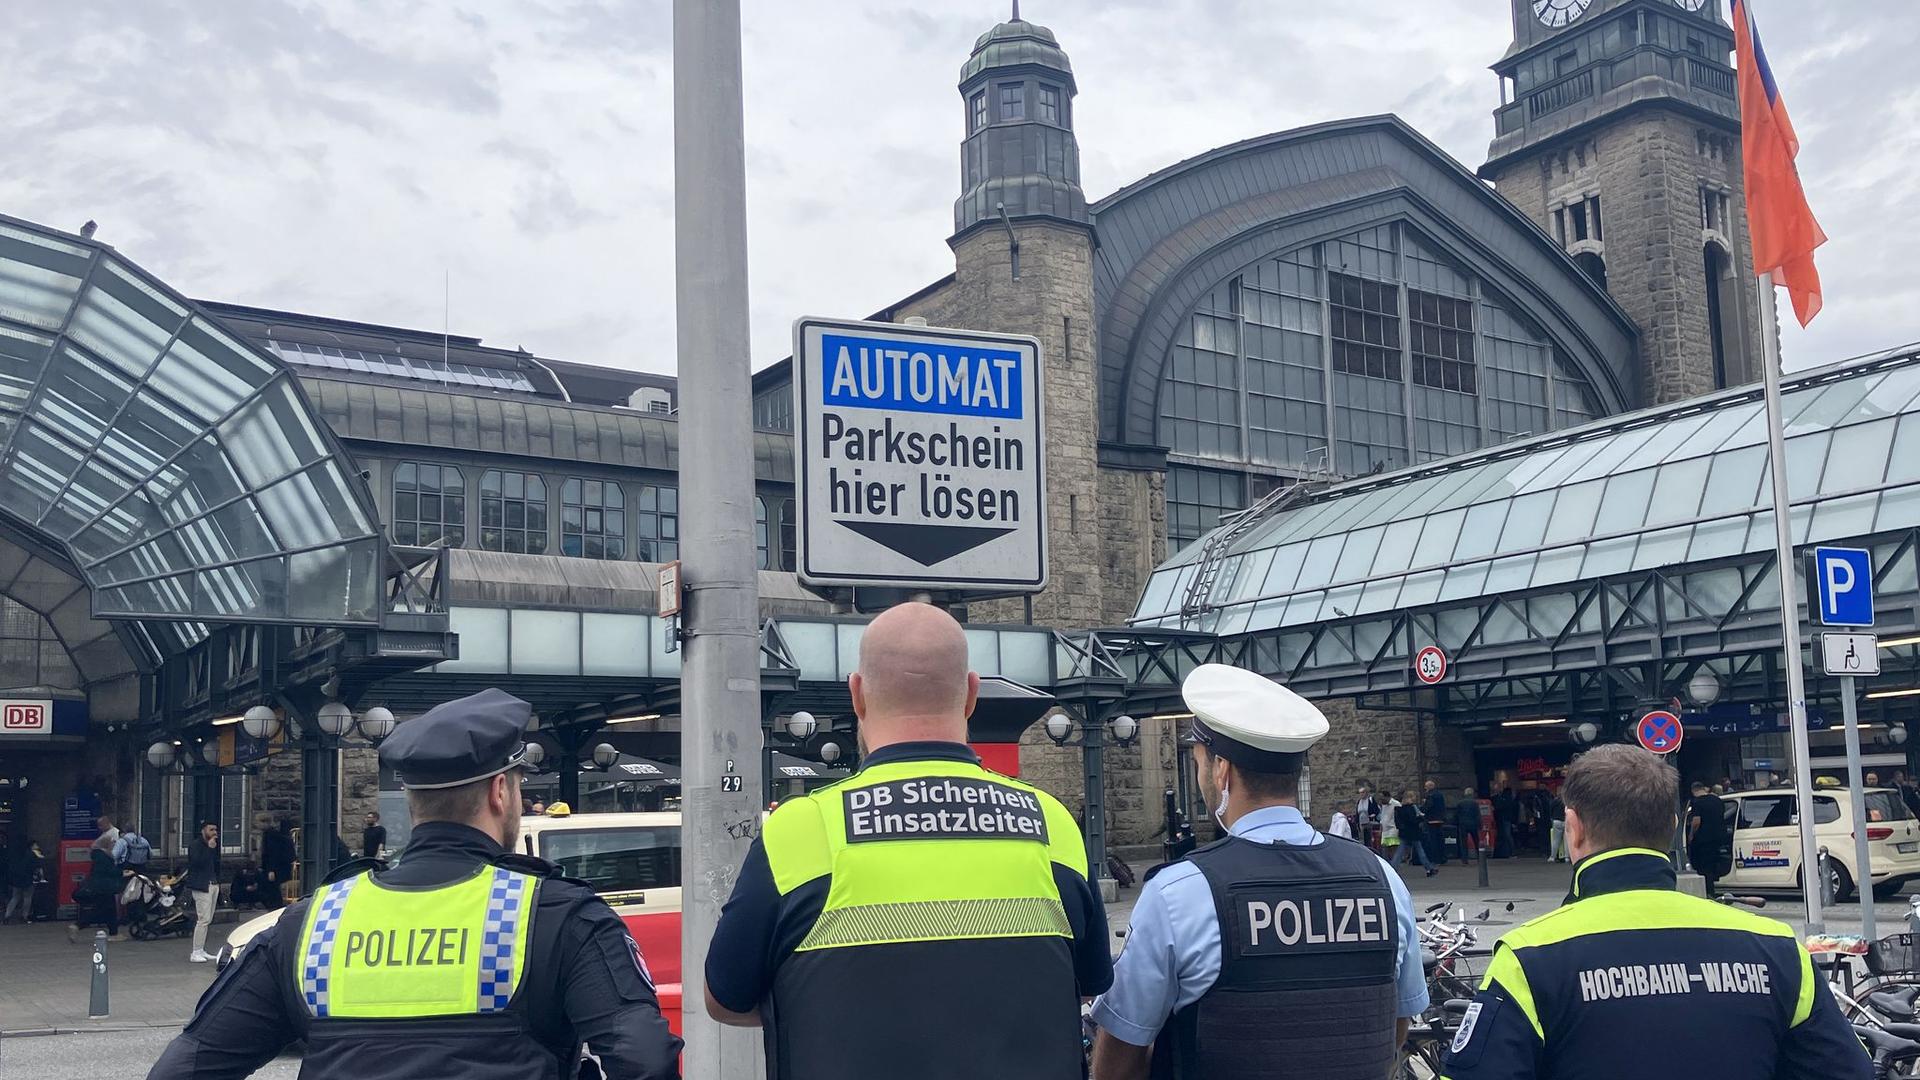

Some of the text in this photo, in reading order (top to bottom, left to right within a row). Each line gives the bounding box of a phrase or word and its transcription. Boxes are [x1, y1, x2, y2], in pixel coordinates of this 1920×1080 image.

[831, 346, 1016, 409] AUTOMAT
[822, 413, 1023, 471] Parkschein
[830, 467, 1019, 521] hier lösen
[1826, 557, 1855, 615] P
[9, 708, 39, 725] DB
[723, 776, 741, 792] 29
[726, 760, 734, 772] P
[850, 780, 1039, 812] DB Sicherheit
[852, 807, 1042, 836] Einsatzleiter
[1248, 897, 1389, 946] POLIZEI
[345, 928, 469, 968] POLIZEI
[1579, 962, 1771, 1002] HOCHBAHN-WACHE
